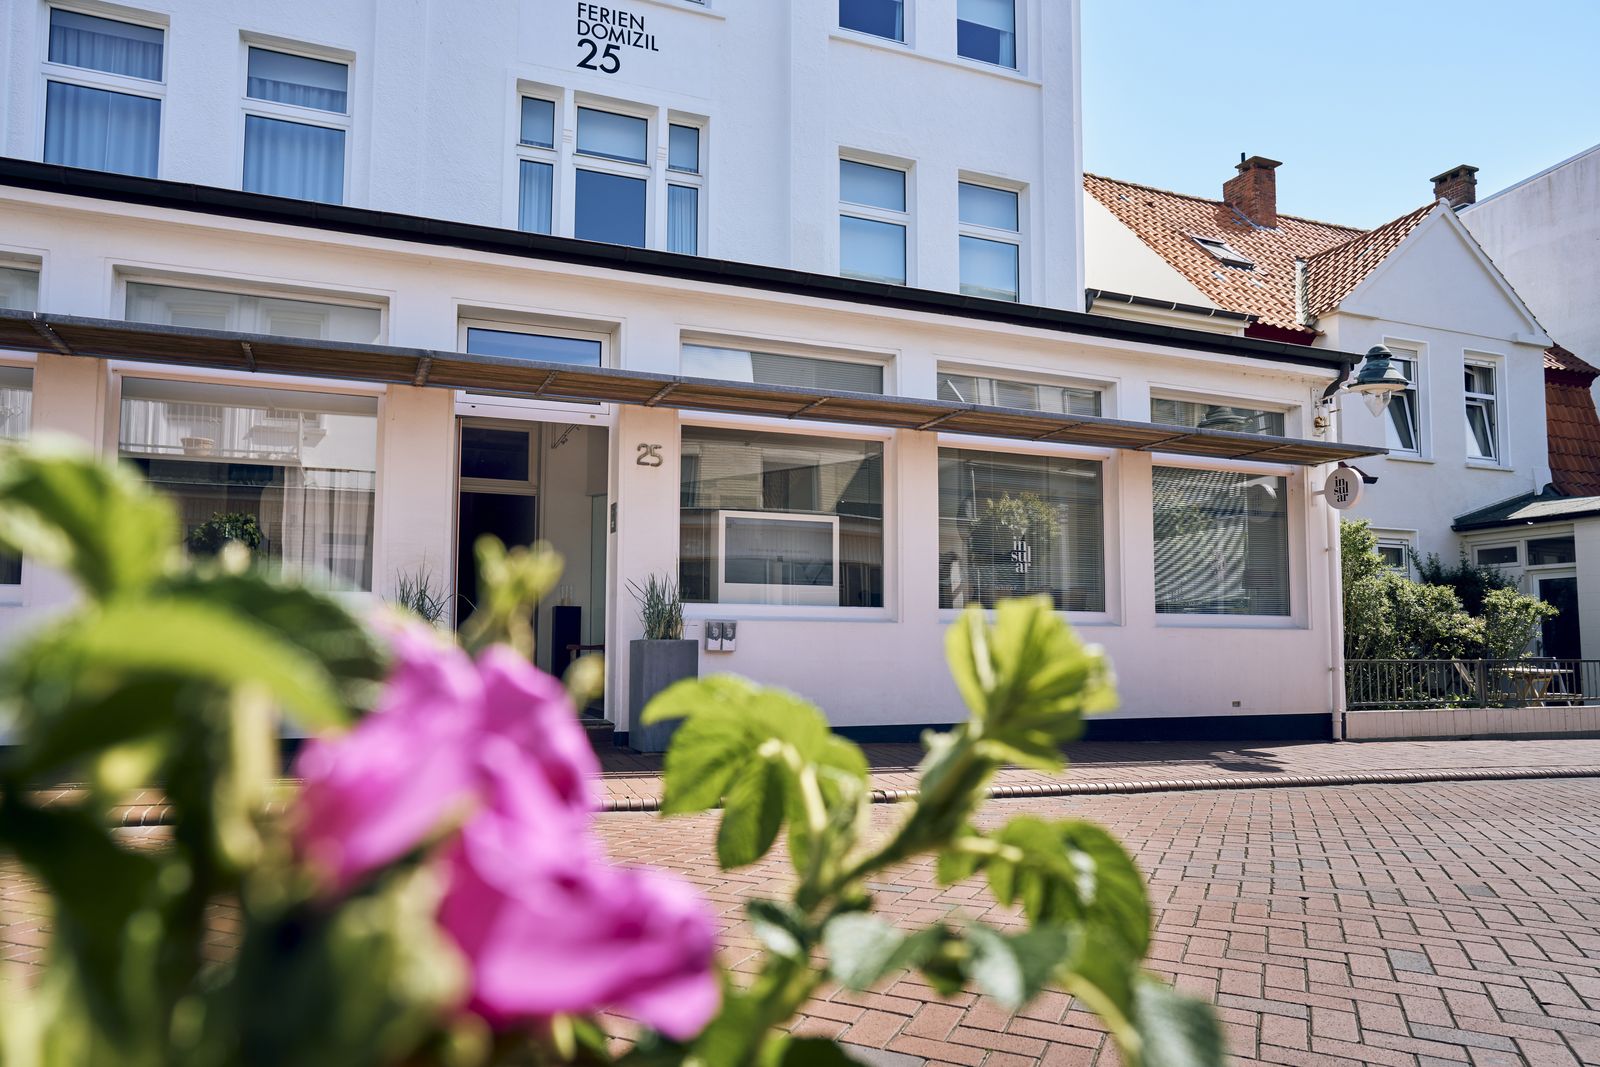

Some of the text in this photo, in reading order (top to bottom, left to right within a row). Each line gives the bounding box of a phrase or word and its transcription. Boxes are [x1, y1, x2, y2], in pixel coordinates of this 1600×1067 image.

[578, 2, 644, 32] FERIEN
[577, 19, 659, 52] DOMIZIL
[577, 38, 620, 74] 25
[637, 443, 663, 467] 25
